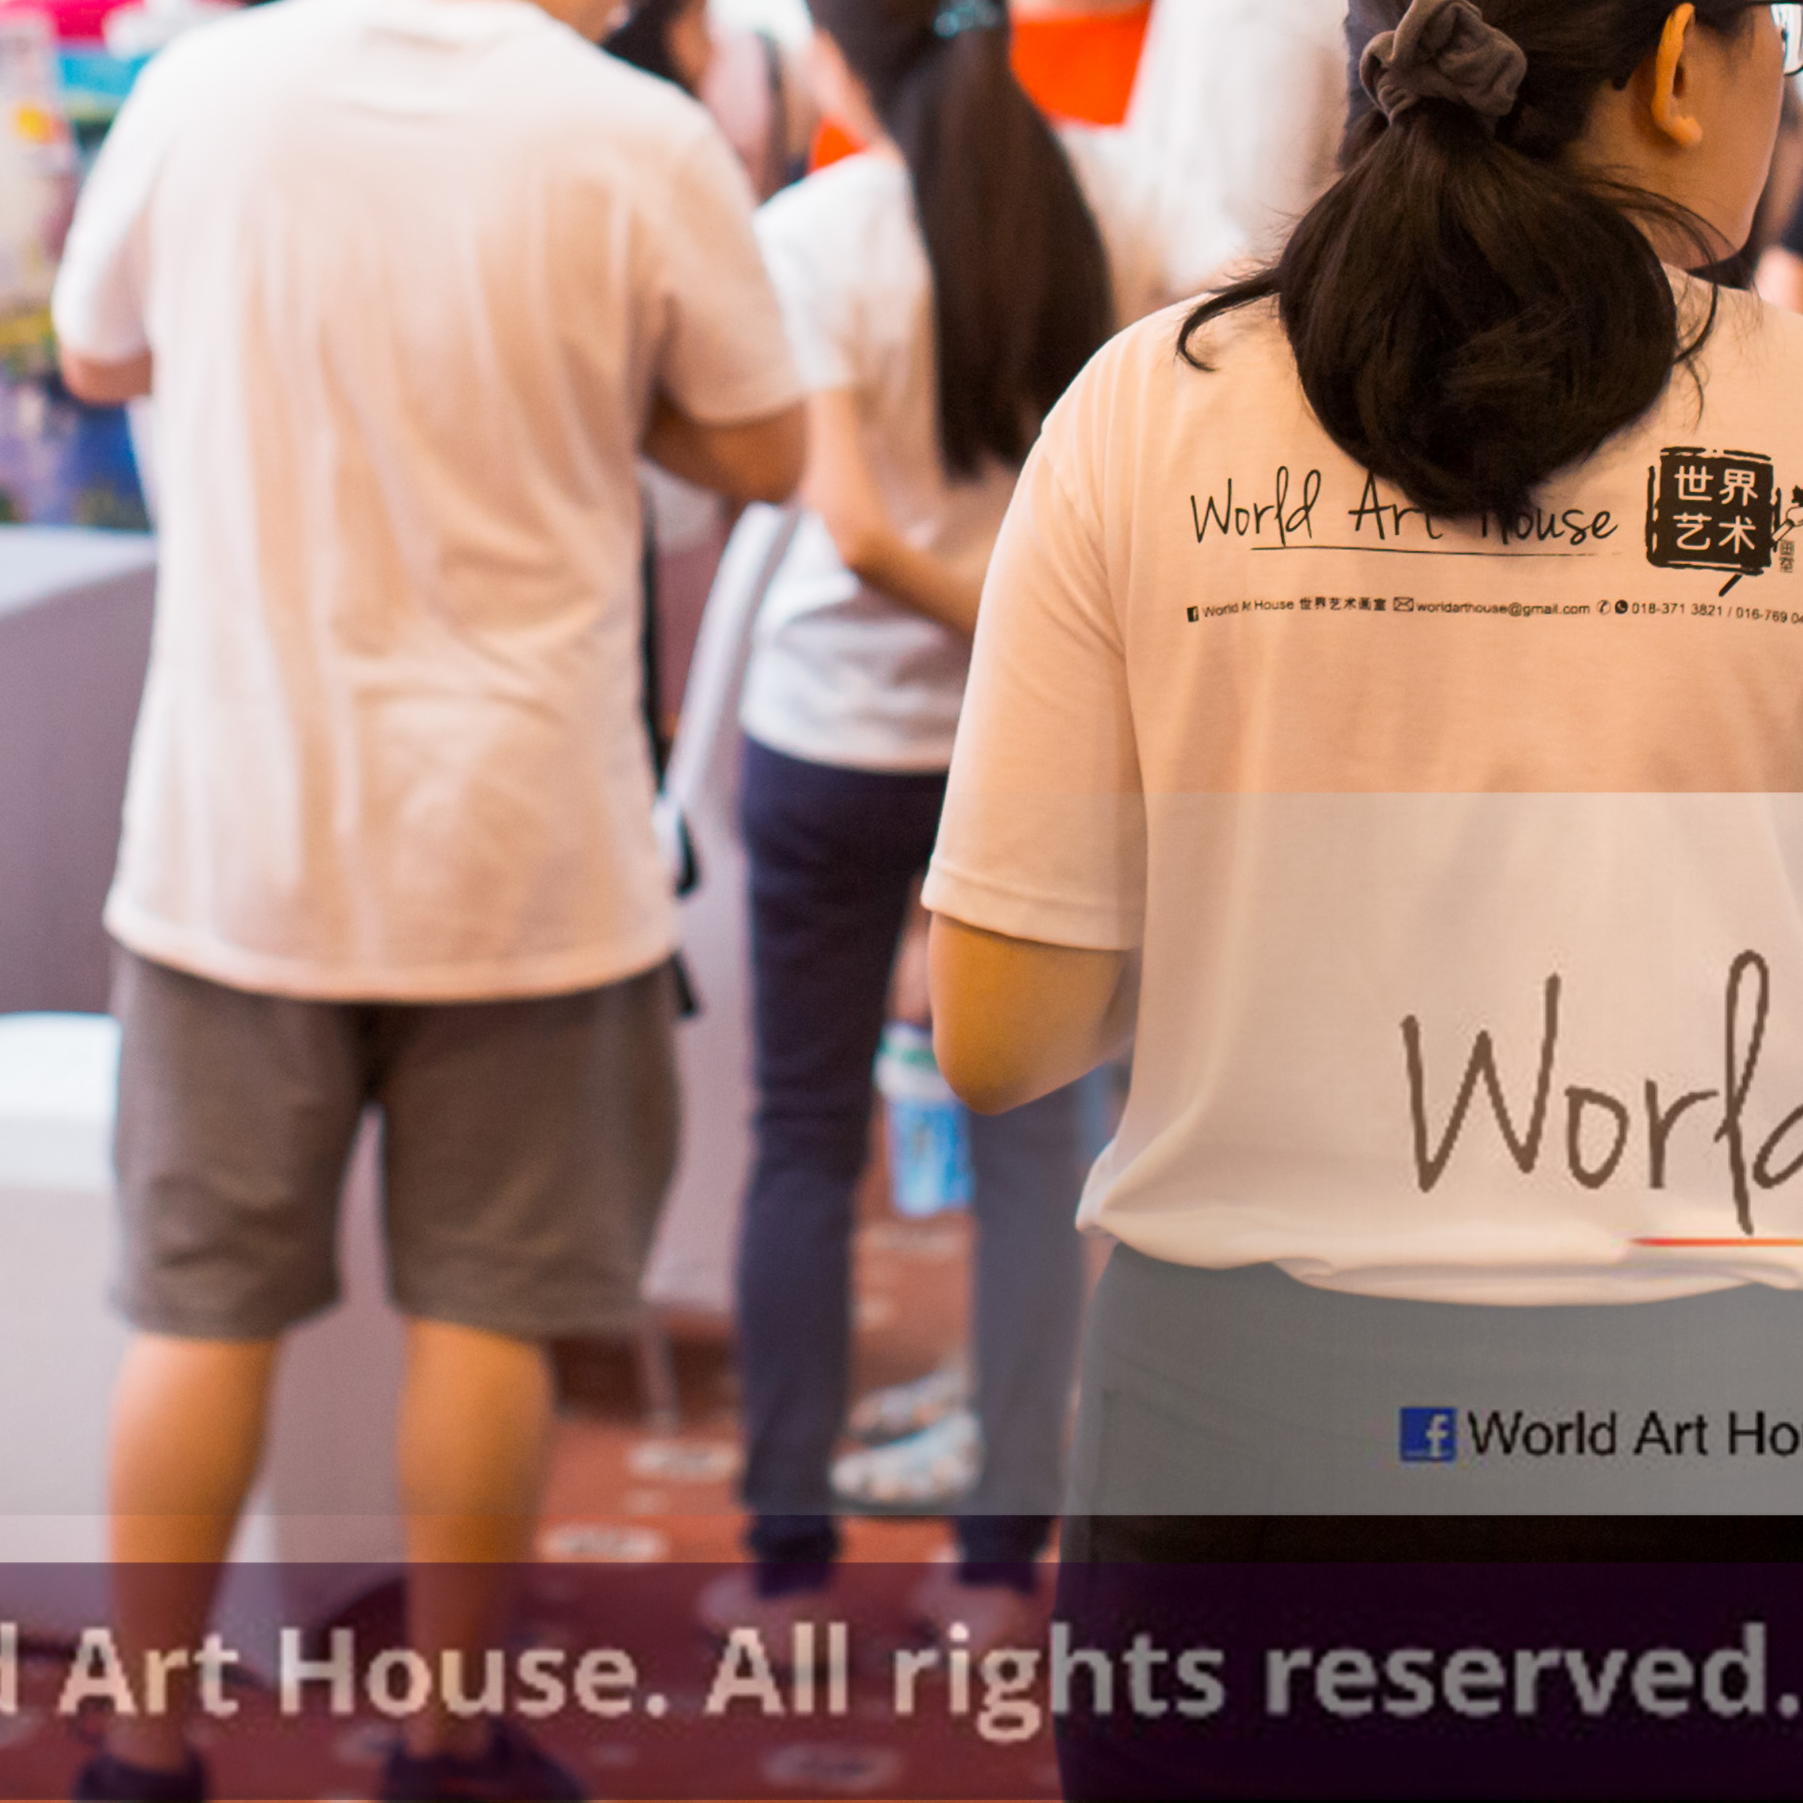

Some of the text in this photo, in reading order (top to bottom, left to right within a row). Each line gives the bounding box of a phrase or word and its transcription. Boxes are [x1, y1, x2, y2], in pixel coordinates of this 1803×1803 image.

[1191, 465, 1321, 546] World
[1674, 465, 1758, 507] 世界
[1673, 512, 1757, 555] 艺术
[1203, 600, 1239, 618] World
[1254, 597, 1295, 611] House
[1300, 597, 1387, 612] 世界艺术画室
[1416, 600, 1590, 618] worldarthouse@gmail.com
[1632, 601, 1685, 615] 018-371
[1691, 602, 1723, 617] 3821
[1736, 605, 1788, 623] 016-769
